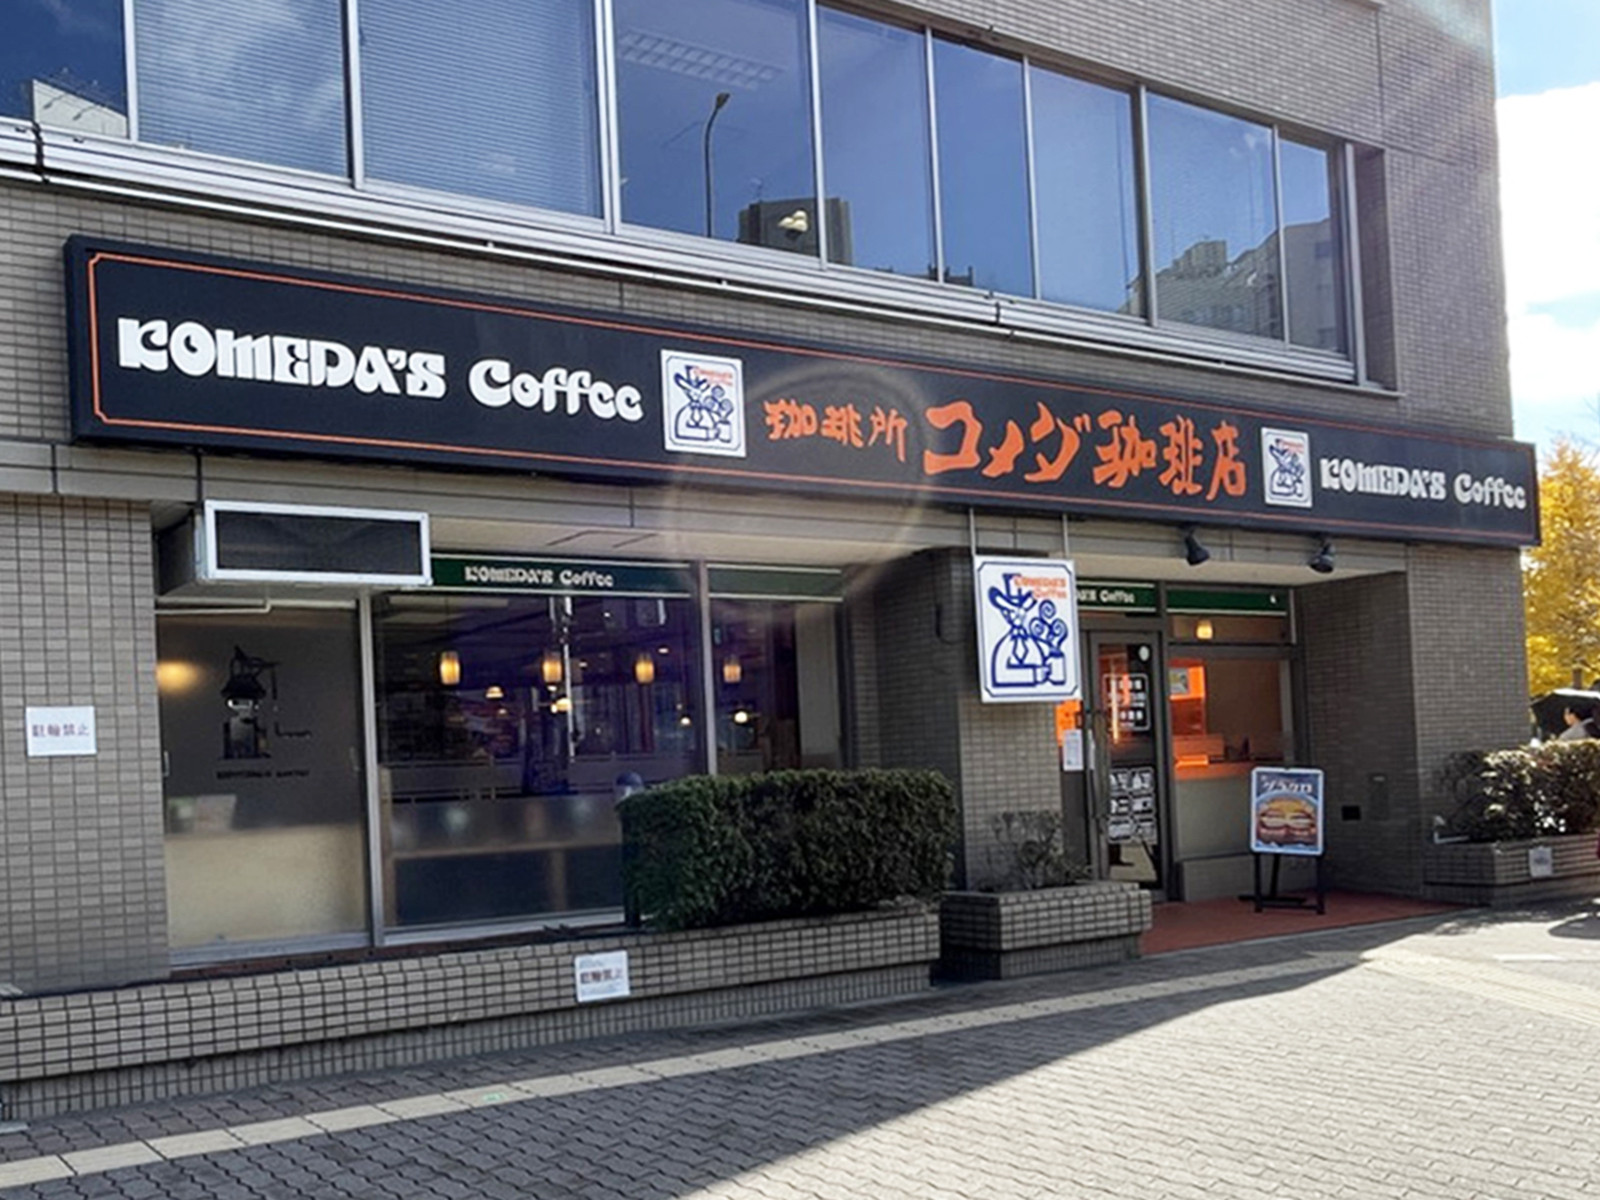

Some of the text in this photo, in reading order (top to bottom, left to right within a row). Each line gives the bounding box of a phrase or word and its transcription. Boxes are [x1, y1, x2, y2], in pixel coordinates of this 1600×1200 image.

[117, 317, 643, 422] KOMEDA'S Coffee
[763, 398, 1248, 502] 珈琲所 コメダ珈琲店
[1319, 457, 1527, 511] KOMEDA'S Coffee
[464, 565, 614, 588] KOMEDA'S Coffee
